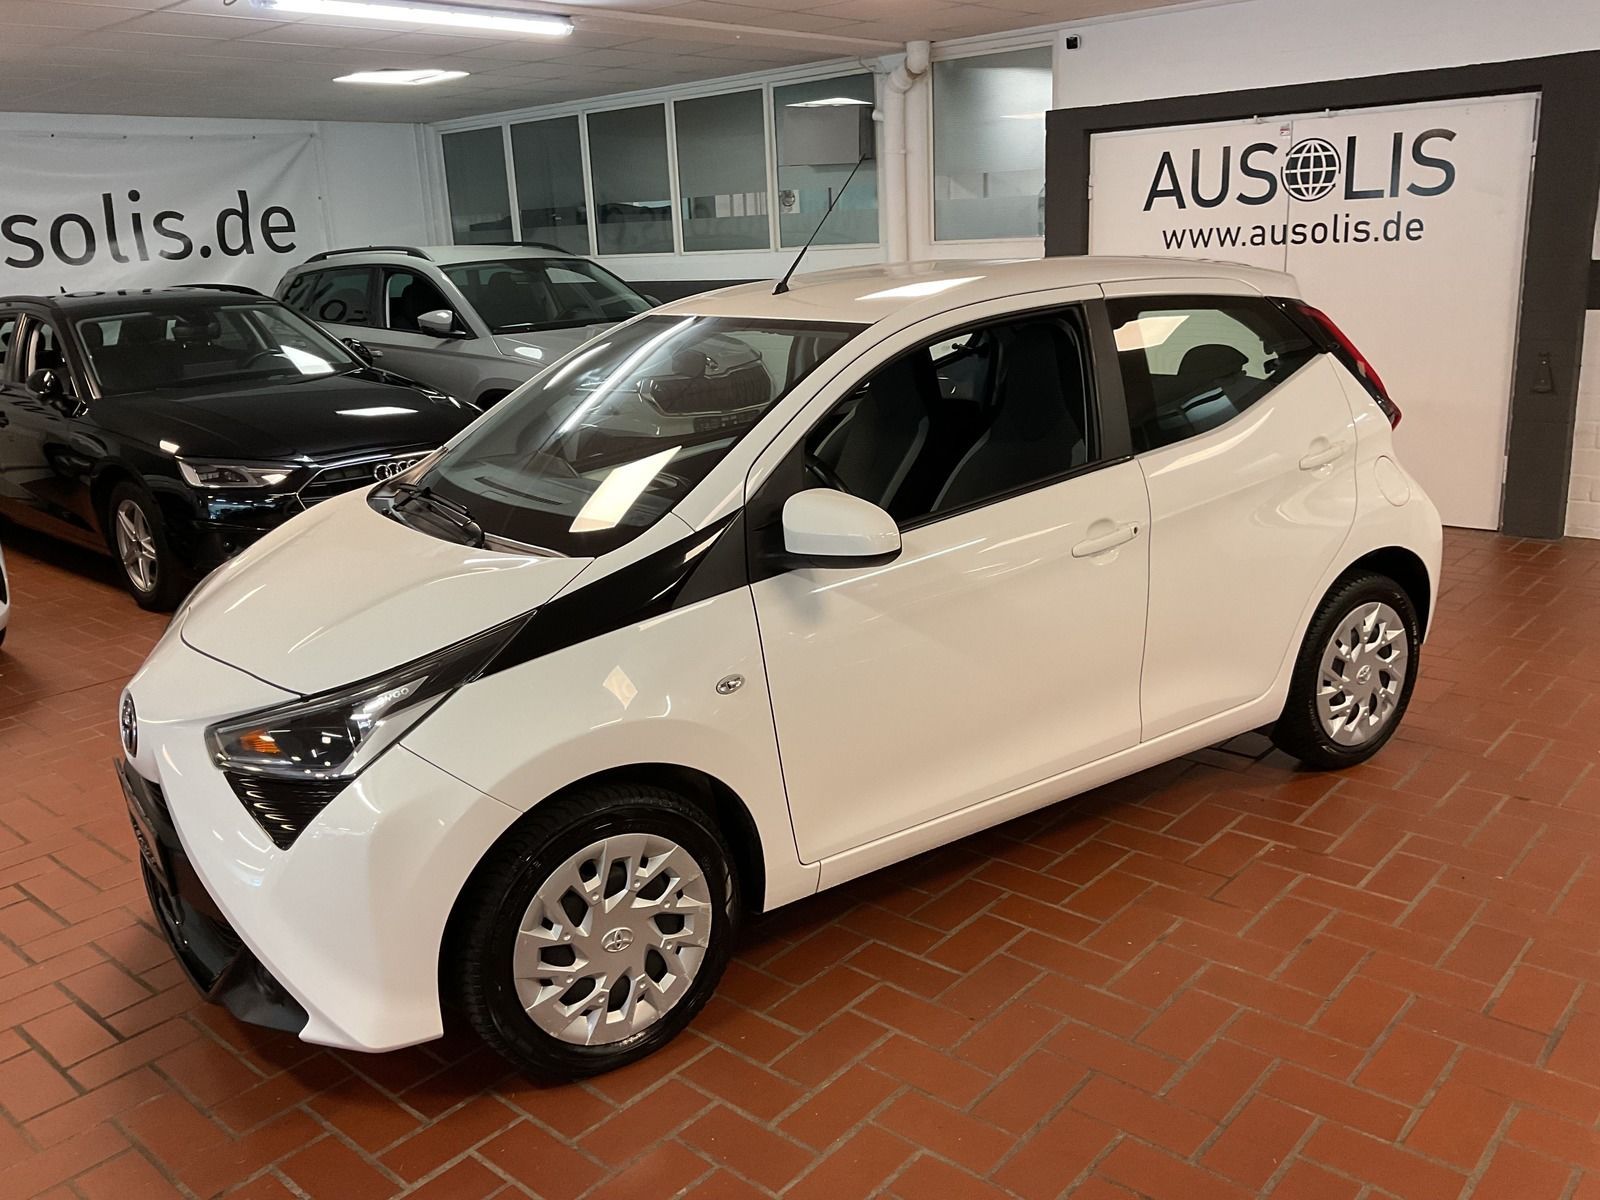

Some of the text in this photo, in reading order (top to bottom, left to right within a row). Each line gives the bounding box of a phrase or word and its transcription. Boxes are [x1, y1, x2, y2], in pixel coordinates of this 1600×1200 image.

[1143, 128, 1457, 212] AUSOLIS
[1, 189, 297, 269] solis.de
[1162, 211, 1424, 250] www.ausolis.de
